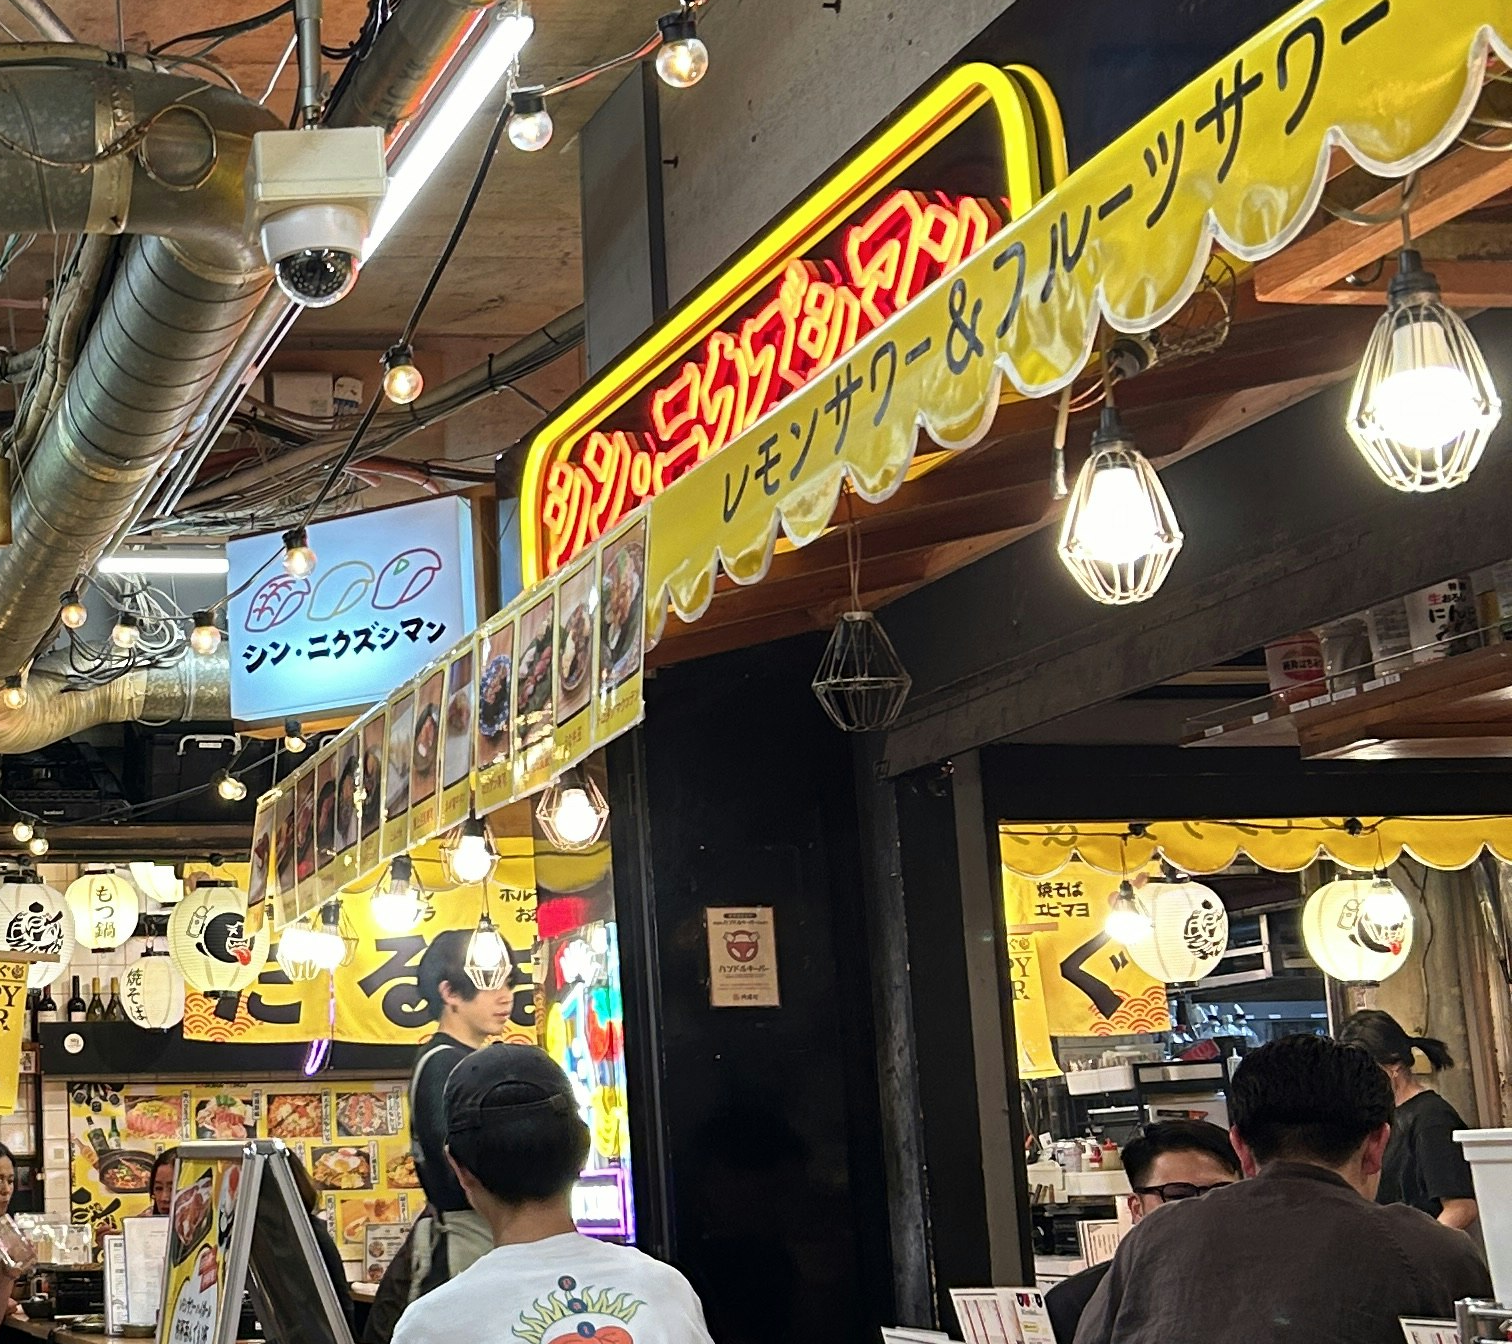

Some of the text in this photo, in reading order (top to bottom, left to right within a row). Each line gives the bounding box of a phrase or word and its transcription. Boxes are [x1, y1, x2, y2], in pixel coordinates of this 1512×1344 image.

[242, 617, 447, 674] シン・ニクズシマン
[94, 885, 116, 939] もつ鍋
[1034, 902, 1090, 917] エビマヨ
[1036, 881, 1083, 898] 焼そば
[126, 967, 148, 1022] 焼そば
